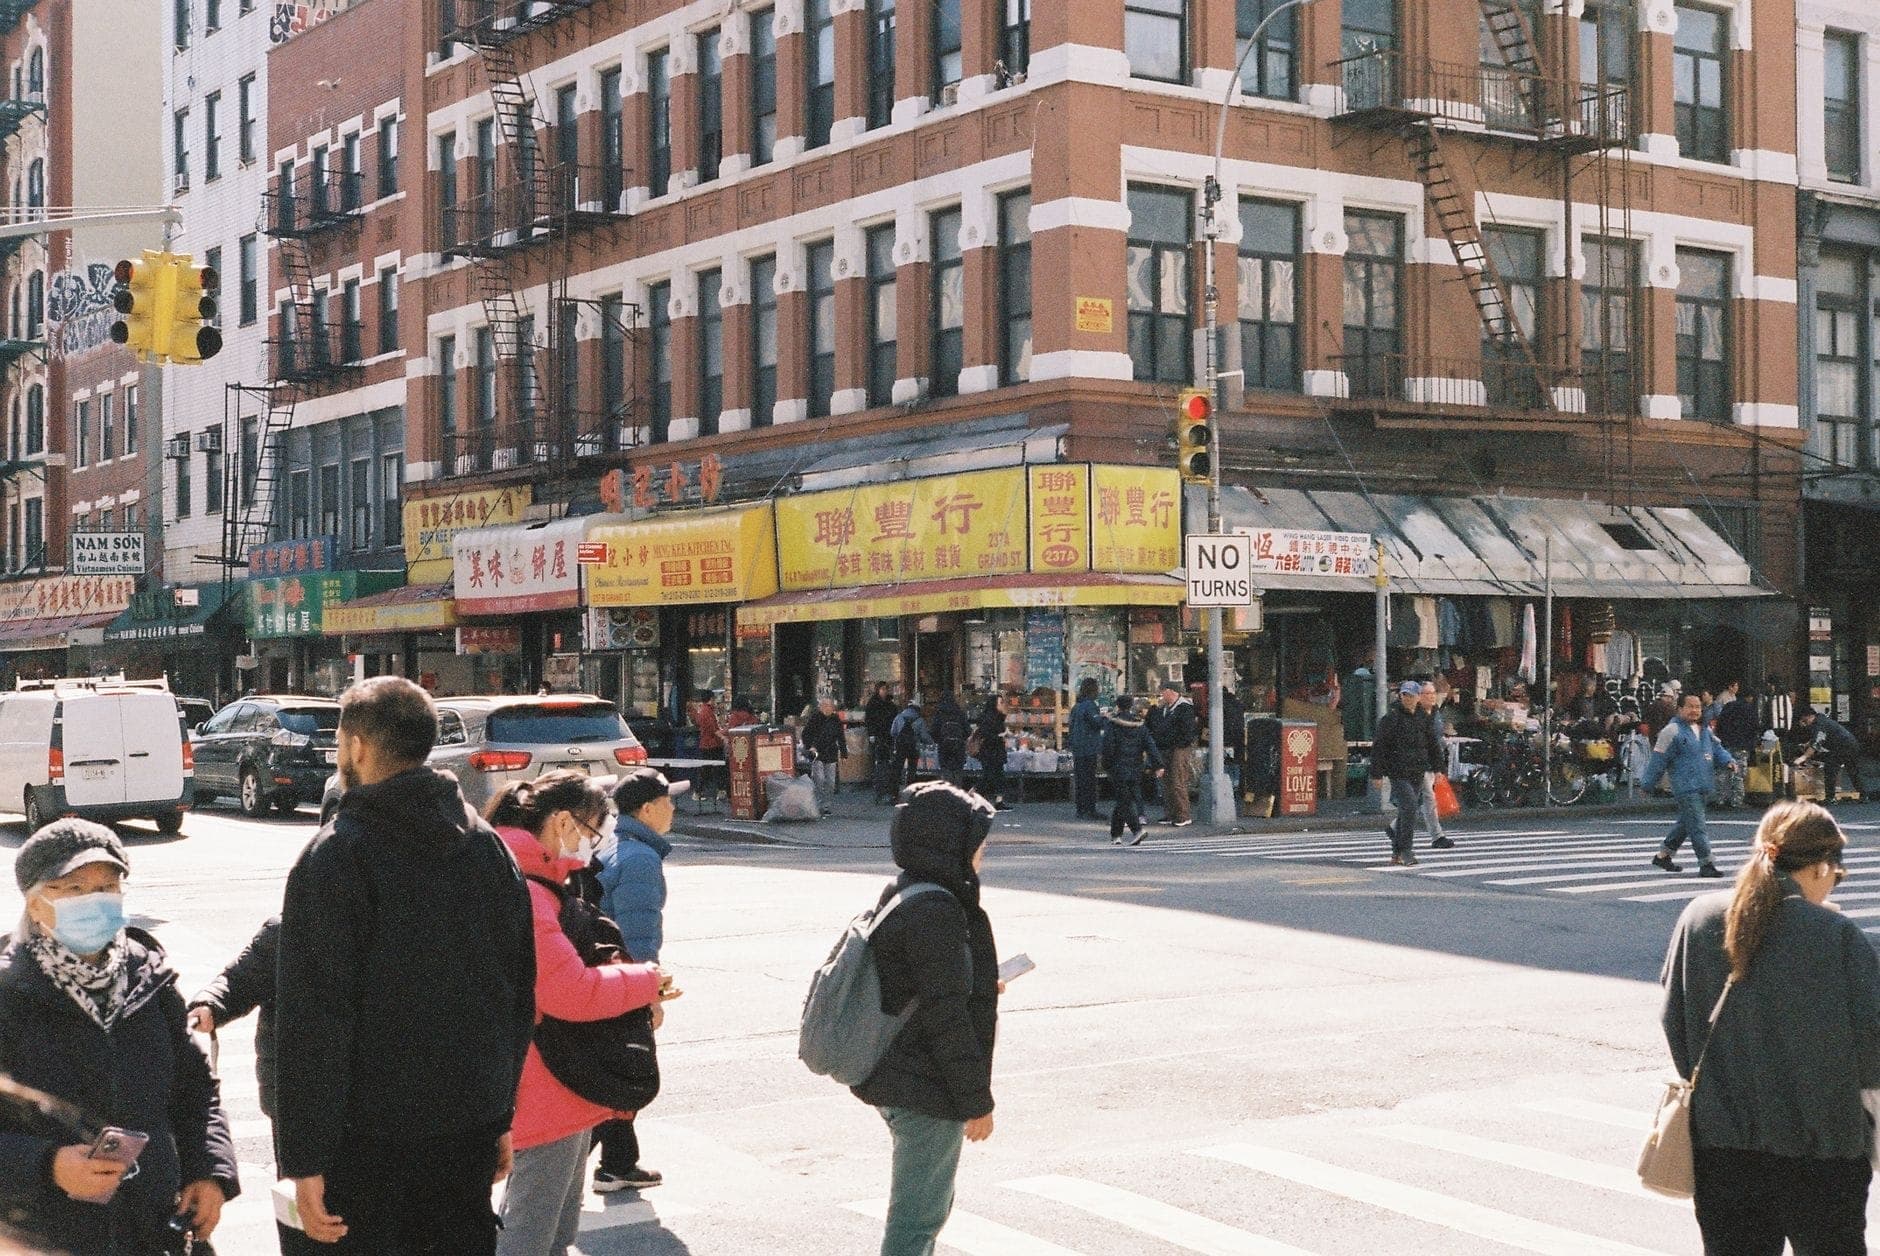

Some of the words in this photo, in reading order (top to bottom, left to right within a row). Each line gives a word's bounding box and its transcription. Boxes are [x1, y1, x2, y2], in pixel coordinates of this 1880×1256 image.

[1038, 470, 1080, 543] 聯豐行
[1097, 486, 1174, 529] 聯豐行
[814, 493, 983, 547] 聯豐行
[75, 537, 108, 550] NAM
[978, 552, 1008, 569] GRAND
[1044, 549, 1076, 562] 237A
[1197, 544, 1240, 570] NO
[1191, 580, 1248, 597] TURNS
[1286, 776, 1313, 792] LOVE
